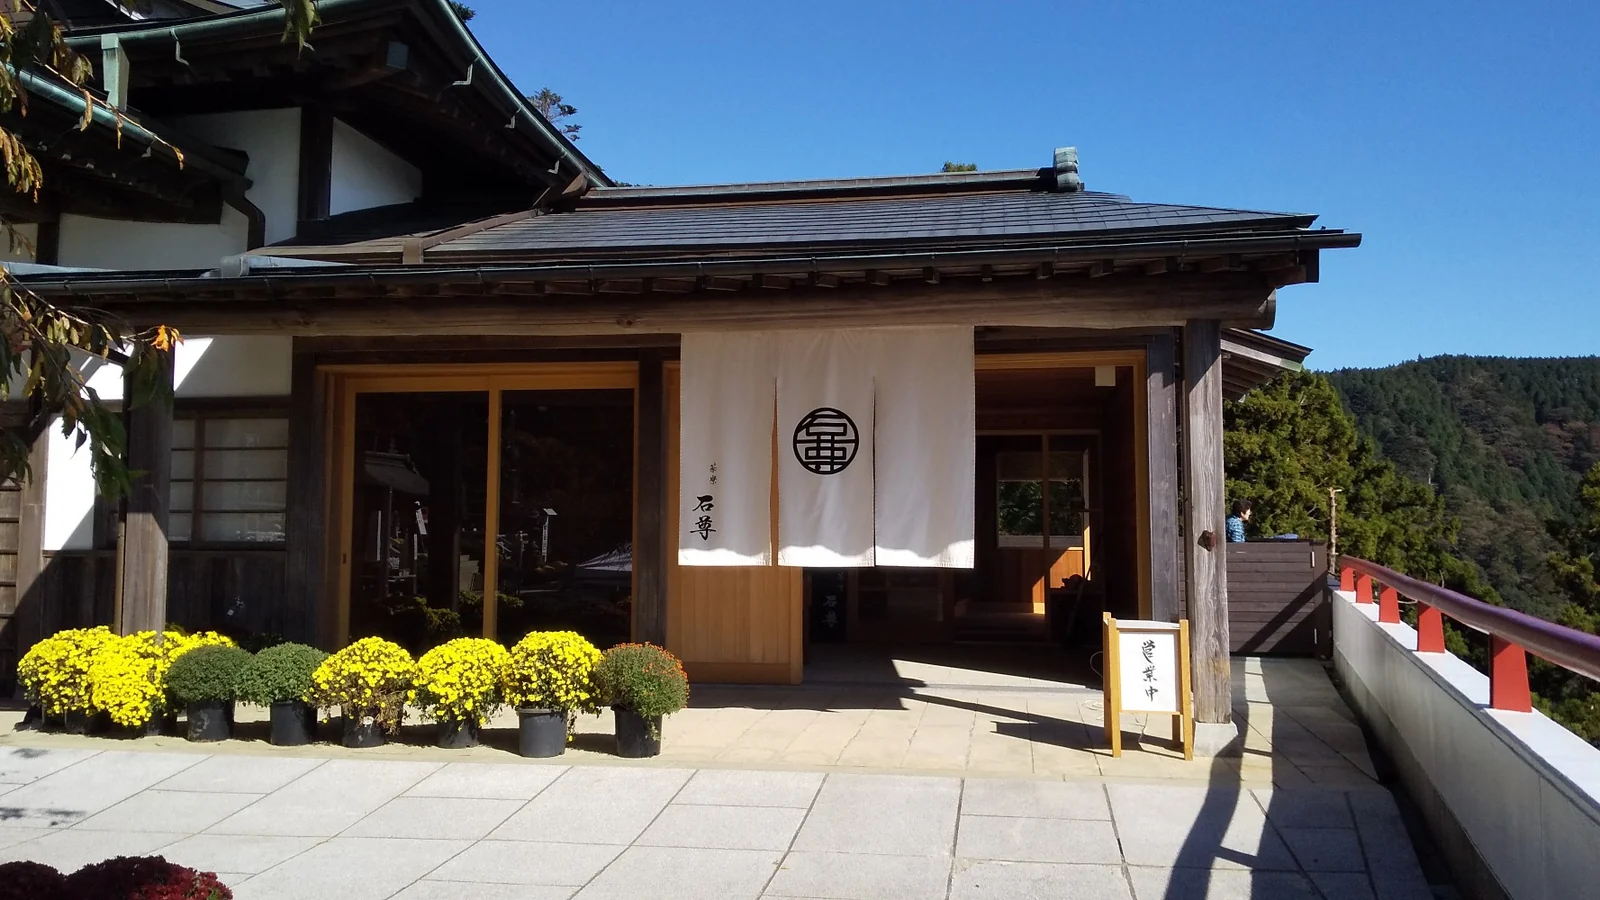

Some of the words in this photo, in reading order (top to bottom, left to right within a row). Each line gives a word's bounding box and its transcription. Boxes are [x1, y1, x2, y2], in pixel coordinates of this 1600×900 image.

[690, 495, 717, 541] 石尊
[1141, 639, 1159, 702] 営業中
